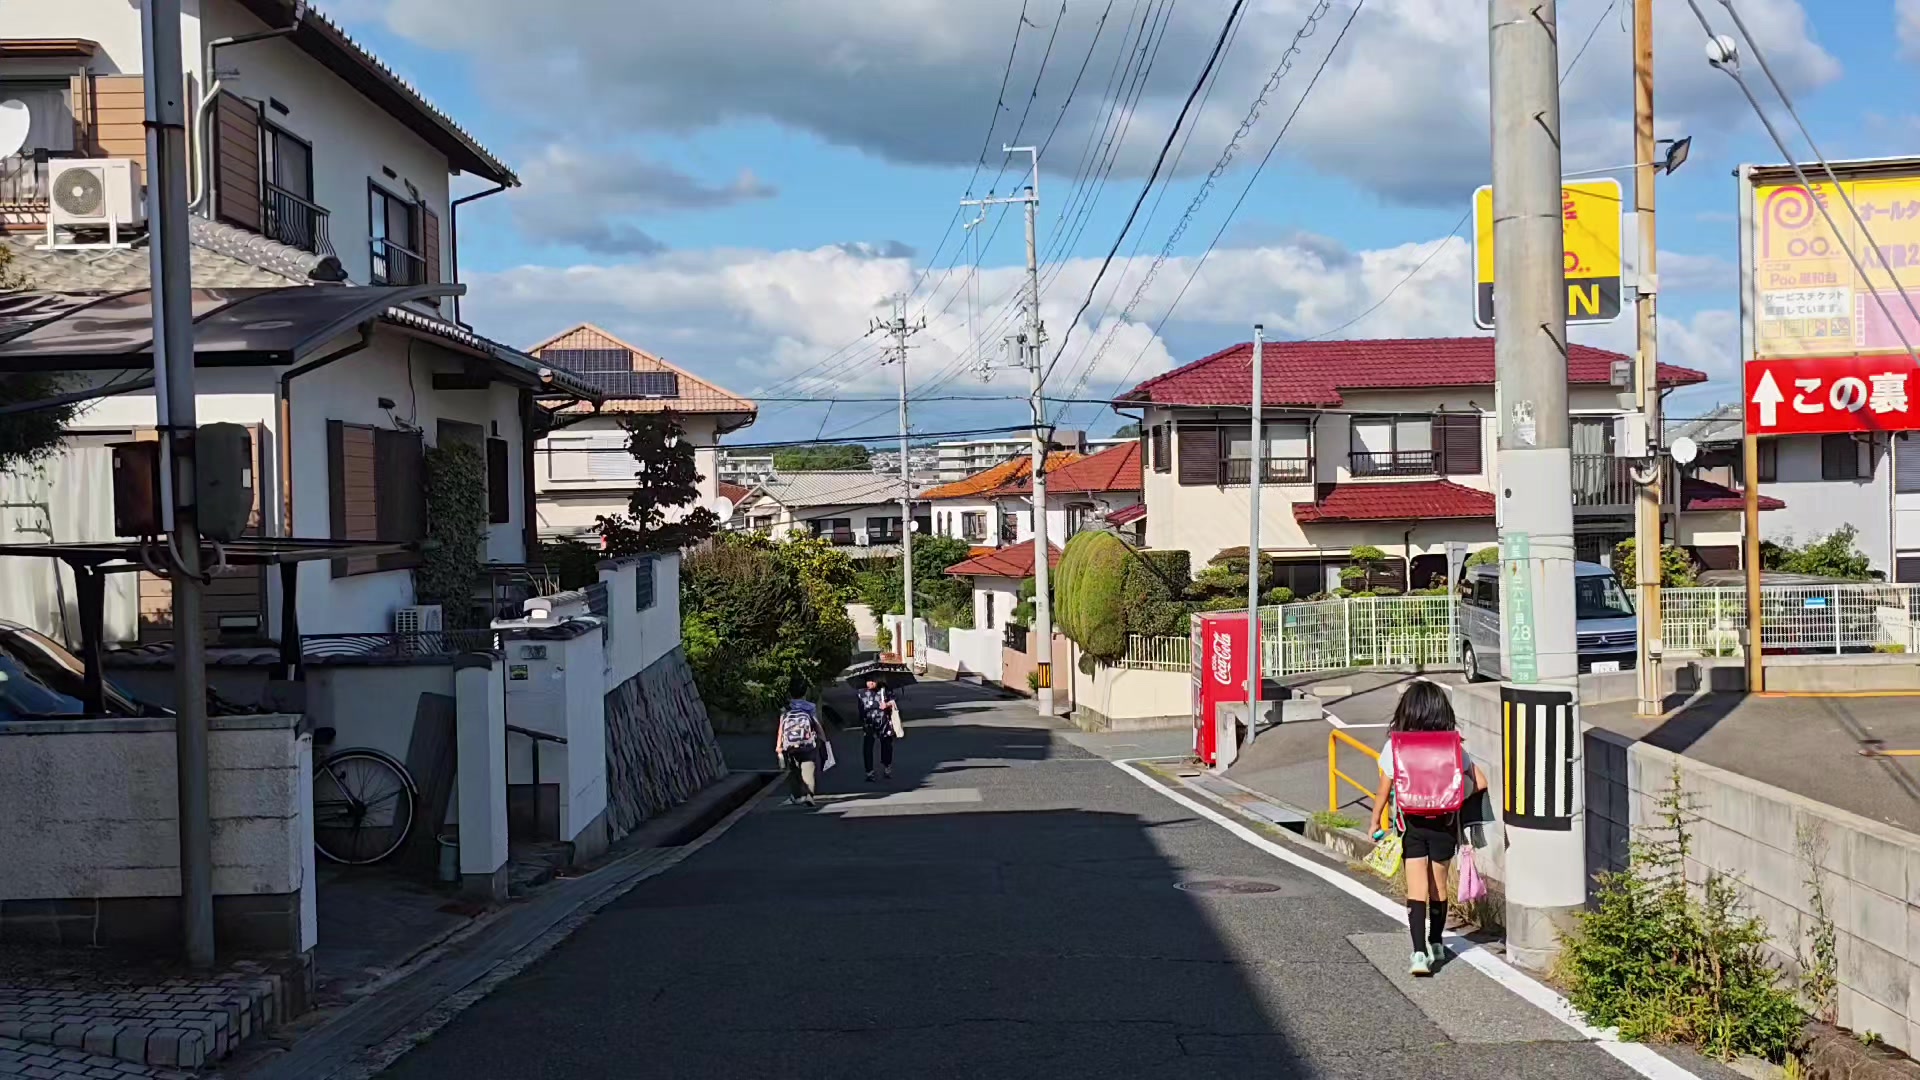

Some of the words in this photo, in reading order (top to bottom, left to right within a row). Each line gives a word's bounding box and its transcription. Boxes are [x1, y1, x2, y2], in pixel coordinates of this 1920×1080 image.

[1792, 372, 1908, 414] この裏
[1511, 626, 1531, 641] 28
[1213, 631, 1232, 685] Coca-Cola
